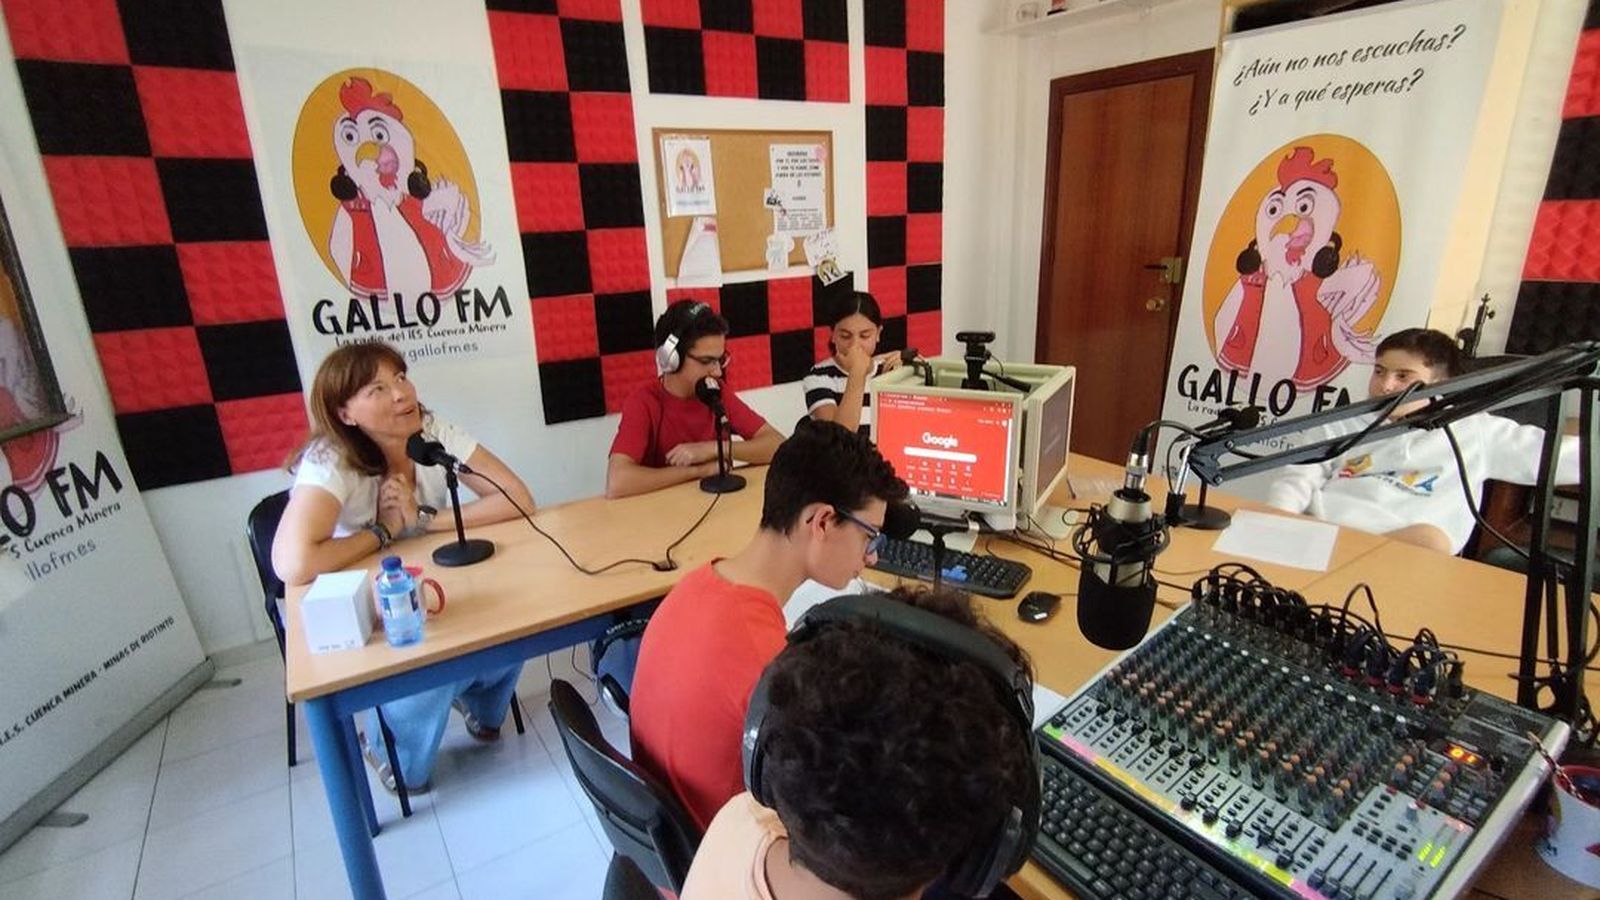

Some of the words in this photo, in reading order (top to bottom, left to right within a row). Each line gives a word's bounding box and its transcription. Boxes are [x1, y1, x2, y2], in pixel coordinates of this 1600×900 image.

[1233, 56, 1282, 87] ¿Aún
[1284, 57, 1309, 74] no
[1312, 49, 1348, 68] nos
[1351, 23, 1467, 64] escuchas?
[1248, 88, 1277, 117] ¿Y
[1278, 92, 1288, 106] a
[1294, 81, 1330, 111] qué
[1331, 67, 1425, 105] esperas?
[312, 291, 441, 336] GALLO
[455, 285, 513, 323] FM
[335, 335, 350, 347] La
[353, 332, 385, 346] radio
[387, 331, 406, 343] del
[408, 329, 424, 341] IES
[427, 325, 467, 339] Cuenca
[468, 323, 507, 335] Minera
[1177, 363, 1297, 417] GALLO
[1187, 400, 1200, 413] La
[921, 431, 959, 449] Google
[45, 450, 123, 518] FM
[24, 524, 74, 553] Cuenca
[76, 502, 122, 529] Minera
[24, 694, 63, 727] CUENCA
[62, 669, 99, 700] MINERA
[102, 646, 131, 671] MINAS
[129, 641, 142, 653] DE
[140, 615, 175, 645] RIOTINTO
